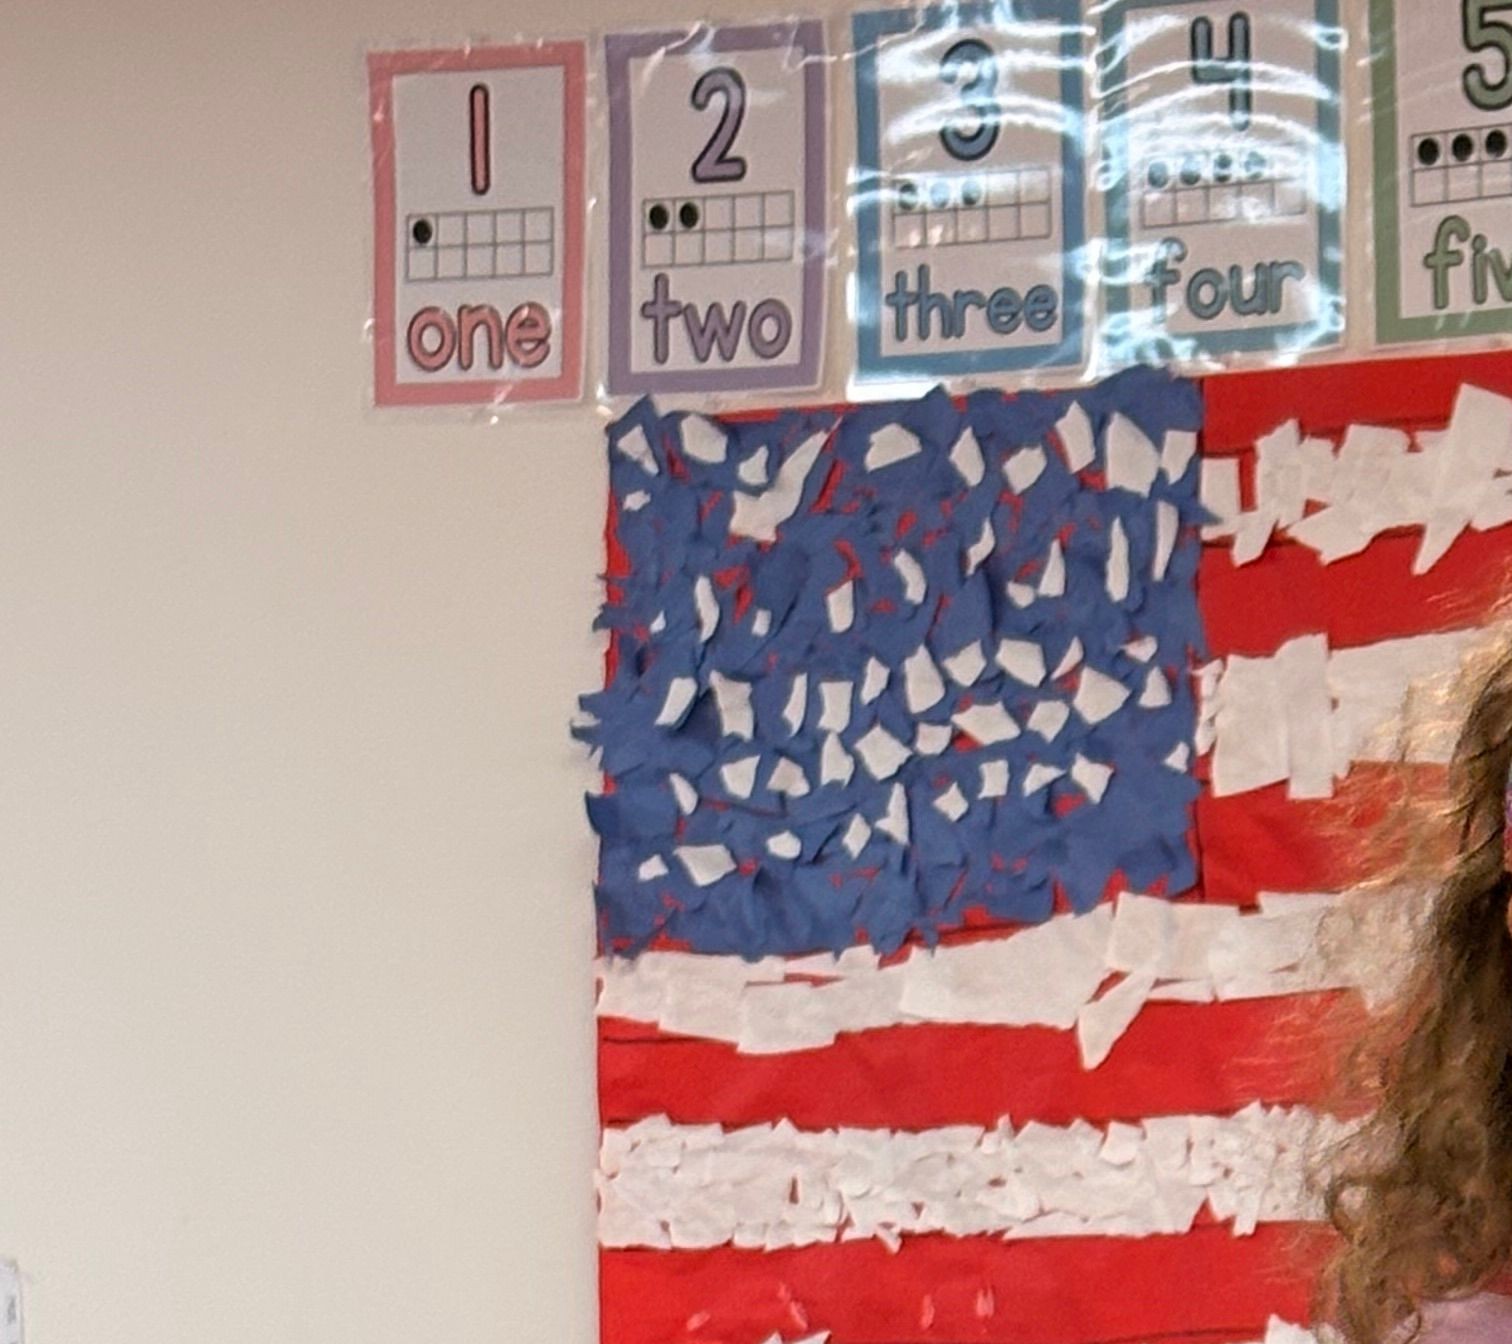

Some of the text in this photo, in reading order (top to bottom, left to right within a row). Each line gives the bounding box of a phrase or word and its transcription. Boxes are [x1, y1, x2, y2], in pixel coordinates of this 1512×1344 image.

[938, 39, 999, 161] 3
[1190, 10, 1251, 131] 4
[469, 84, 490, 195] 1
[691, 67, 746, 183] 2
[642, 274, 791, 362] two
[886, 264, 1057, 341] three
[1144, 238, 1302, 322] four
[407, 302, 551, 371] one
